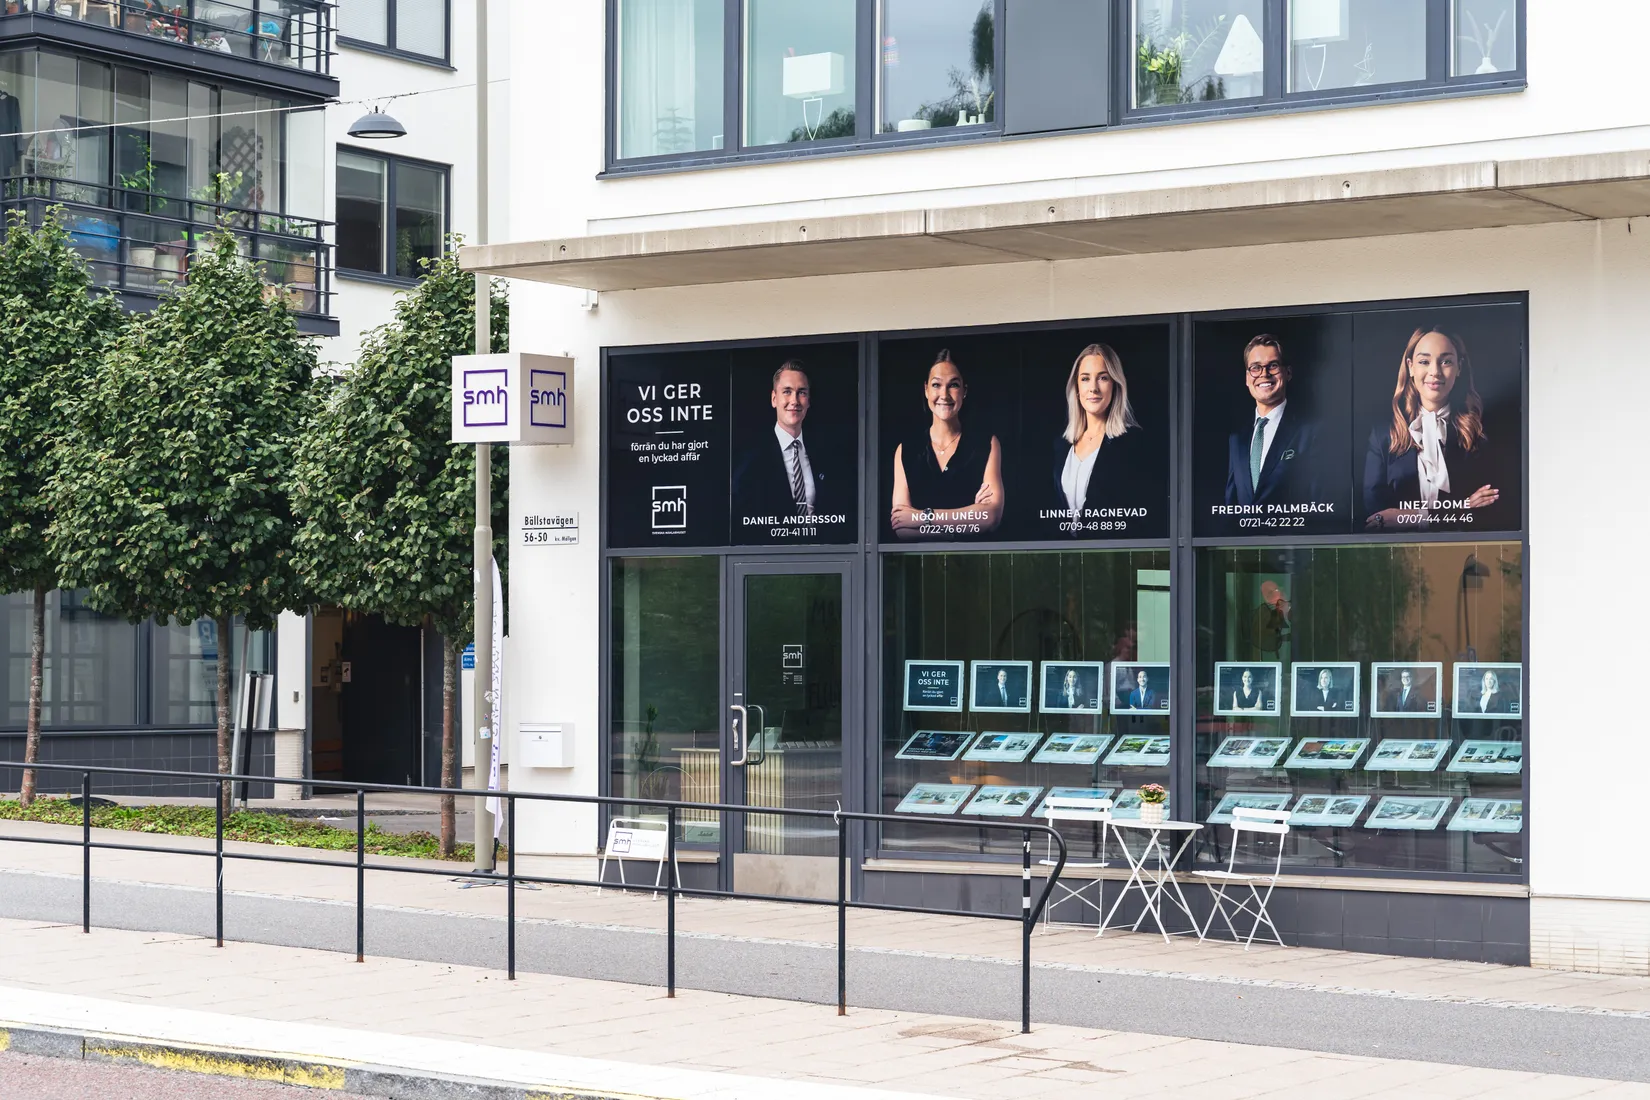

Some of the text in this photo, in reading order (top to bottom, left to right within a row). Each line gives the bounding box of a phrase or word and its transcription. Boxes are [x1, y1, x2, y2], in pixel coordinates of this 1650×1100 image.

[463, 385, 508, 405] smh
[530, 387, 566, 406] smh
[638, 383, 701, 401] VI GER
[627, 404, 713, 424] OSS INTE
[630, 439, 709, 451] förrän du har gjort
[638, 452, 701, 464] en lyckad affär
[652, 498, 686, 512] smh
[1211, 501, 1334, 515] FREDRIK PALMBÄCK
[1399, 497, 1471, 510] INEZ DOMÉ
[911, 509, 989, 522] NOOMI UNÉUS
[1039, 507, 1148, 519] LINNEA RAGNEVAD
[1397, 513, 1474, 524] 0707-44 44 46
[524, 515, 574, 528] Bällstavägen
[742, 514, 846, 526] DANIEL ANDERSSON
[1059, 521, 1127, 531] 0709-48 88 99
[1239, 516, 1305, 528] 0721-42 22 22
[770, 527, 817, 537] 0721-41 11 11
[919, 523, 980, 534] 0722-76 67 76
[524, 532, 548, 542] 56-50
[782, 650, 803, 660] smh
